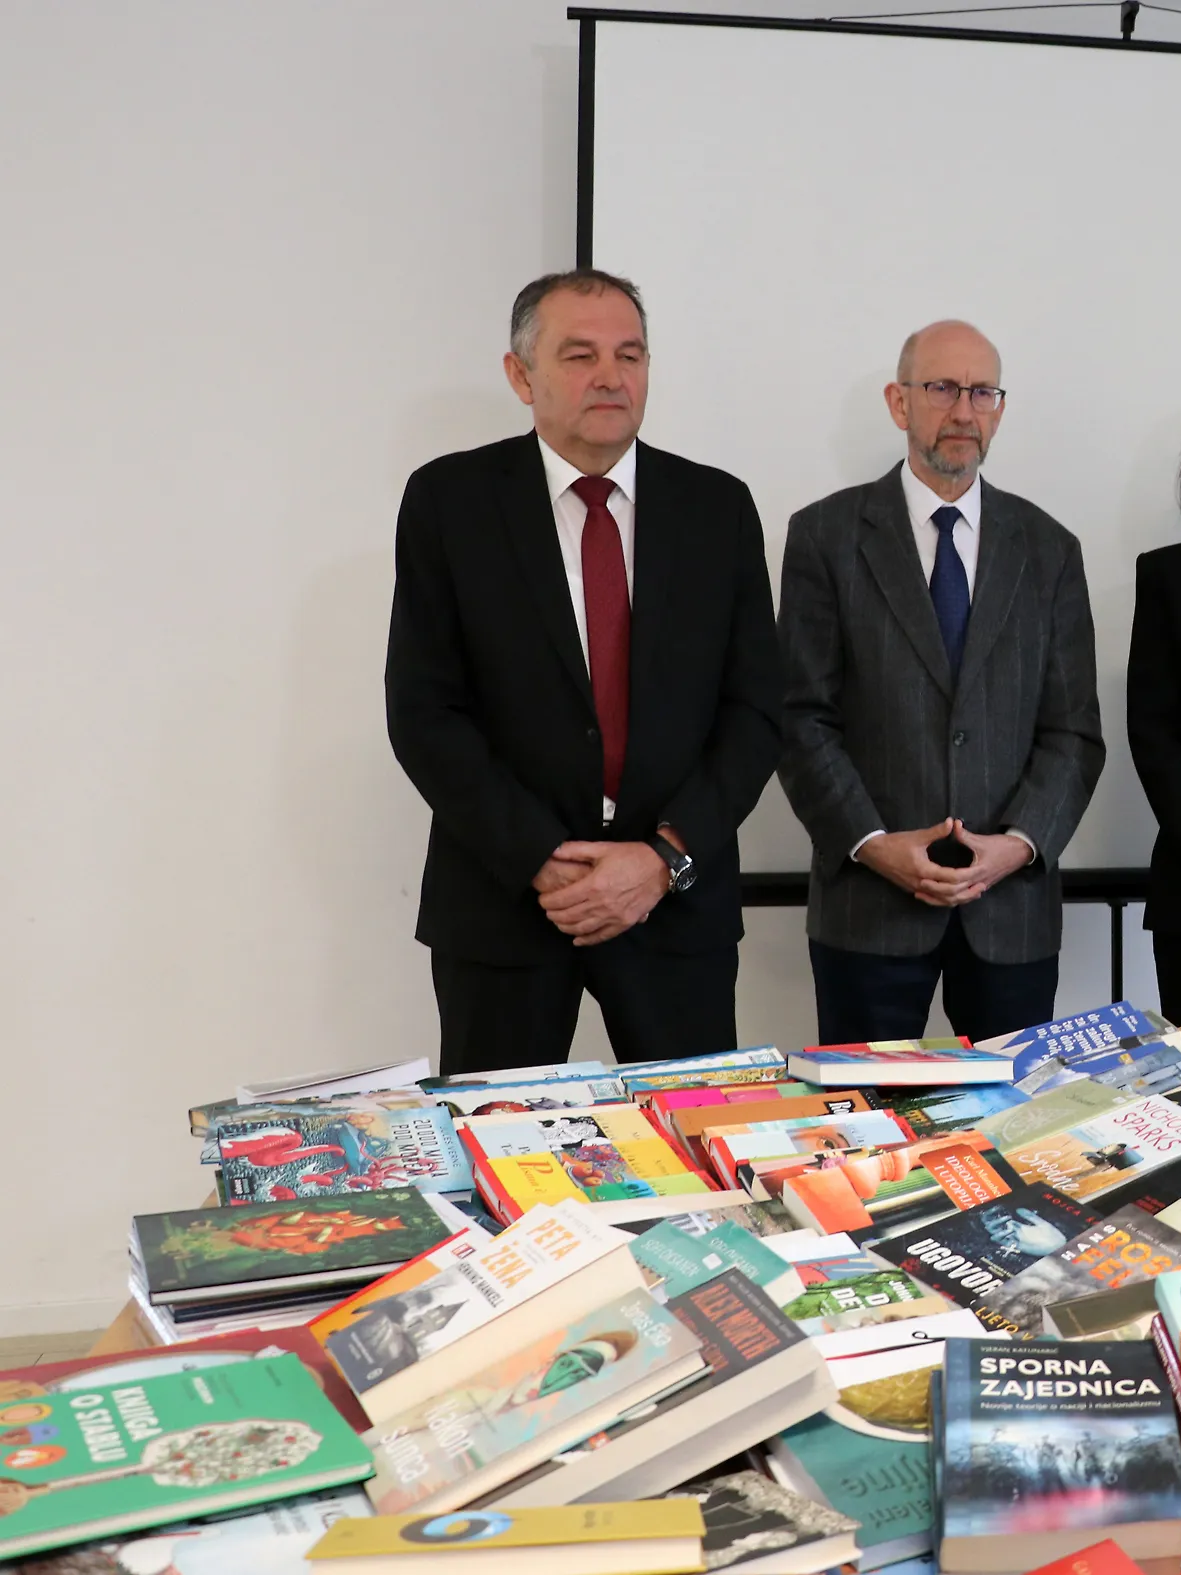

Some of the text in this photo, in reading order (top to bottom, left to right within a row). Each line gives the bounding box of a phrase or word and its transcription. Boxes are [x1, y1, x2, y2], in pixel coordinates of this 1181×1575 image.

[391, 1124, 413, 1140] POD
[447, 1147, 462, 1168] VERNE
[963, 1154, 981, 1171] Karl
[526, 1217, 582, 1262] PETA
[1061, 1223, 1116, 1262] HANS
[480, 1240, 534, 1290] ŽENA
[1072, 1247, 1131, 1290] FEL
[476, 1281, 504, 1309] MANKELL
[690, 1283, 744, 1321] ALEX
[620, 1301, 652, 1335] Jonas
[974, 1307, 1018, 1335] LJETO
[980, 1357, 1112, 1376] SPORNA
[980, 1379, 1161, 1400] ZAJEDNICA
[69, 1394, 128, 1463] O STABLU
[111, 1386, 163, 1442] KNJIGA
